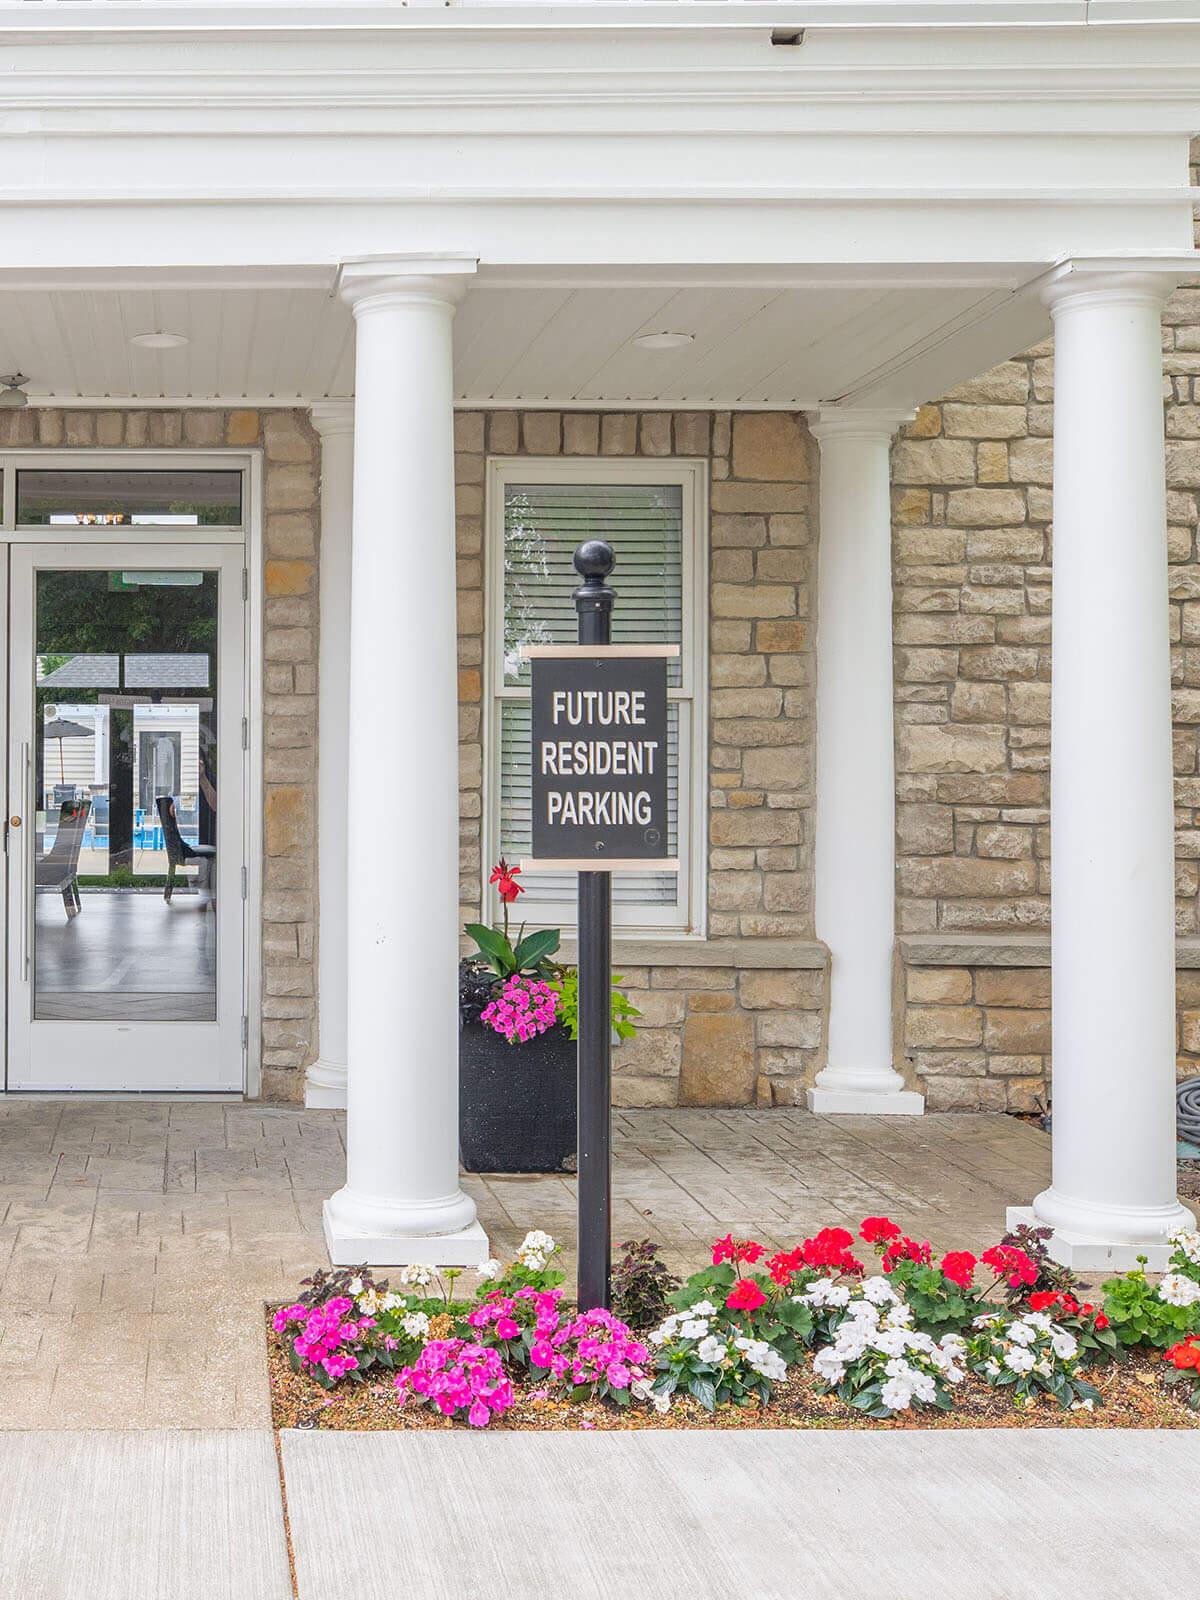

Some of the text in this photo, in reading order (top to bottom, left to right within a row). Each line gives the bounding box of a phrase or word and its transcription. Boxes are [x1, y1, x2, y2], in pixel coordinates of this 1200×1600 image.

[553, 690, 646, 725] FUTURE
[541, 741, 658, 775] RESIDENT
[547, 791, 652, 825] PARKING
